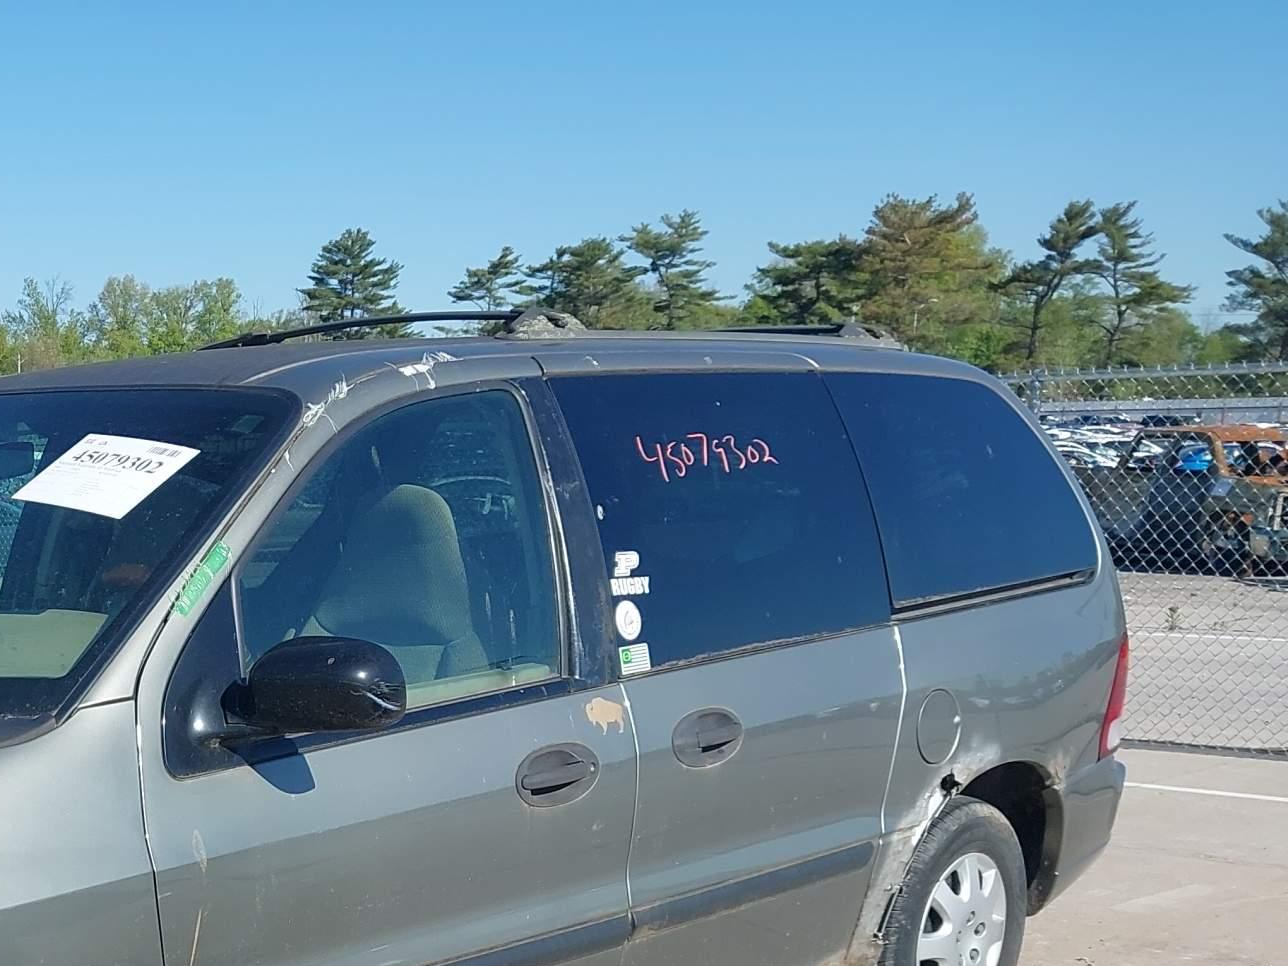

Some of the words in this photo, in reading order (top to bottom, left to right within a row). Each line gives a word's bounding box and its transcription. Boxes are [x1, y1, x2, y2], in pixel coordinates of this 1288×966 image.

[71, 449, 165, 475] 45079302
[635, 432, 780, 483] 45079302
[614, 550, 640, 577] P
[610, 576, 650, 596] RUGBY
